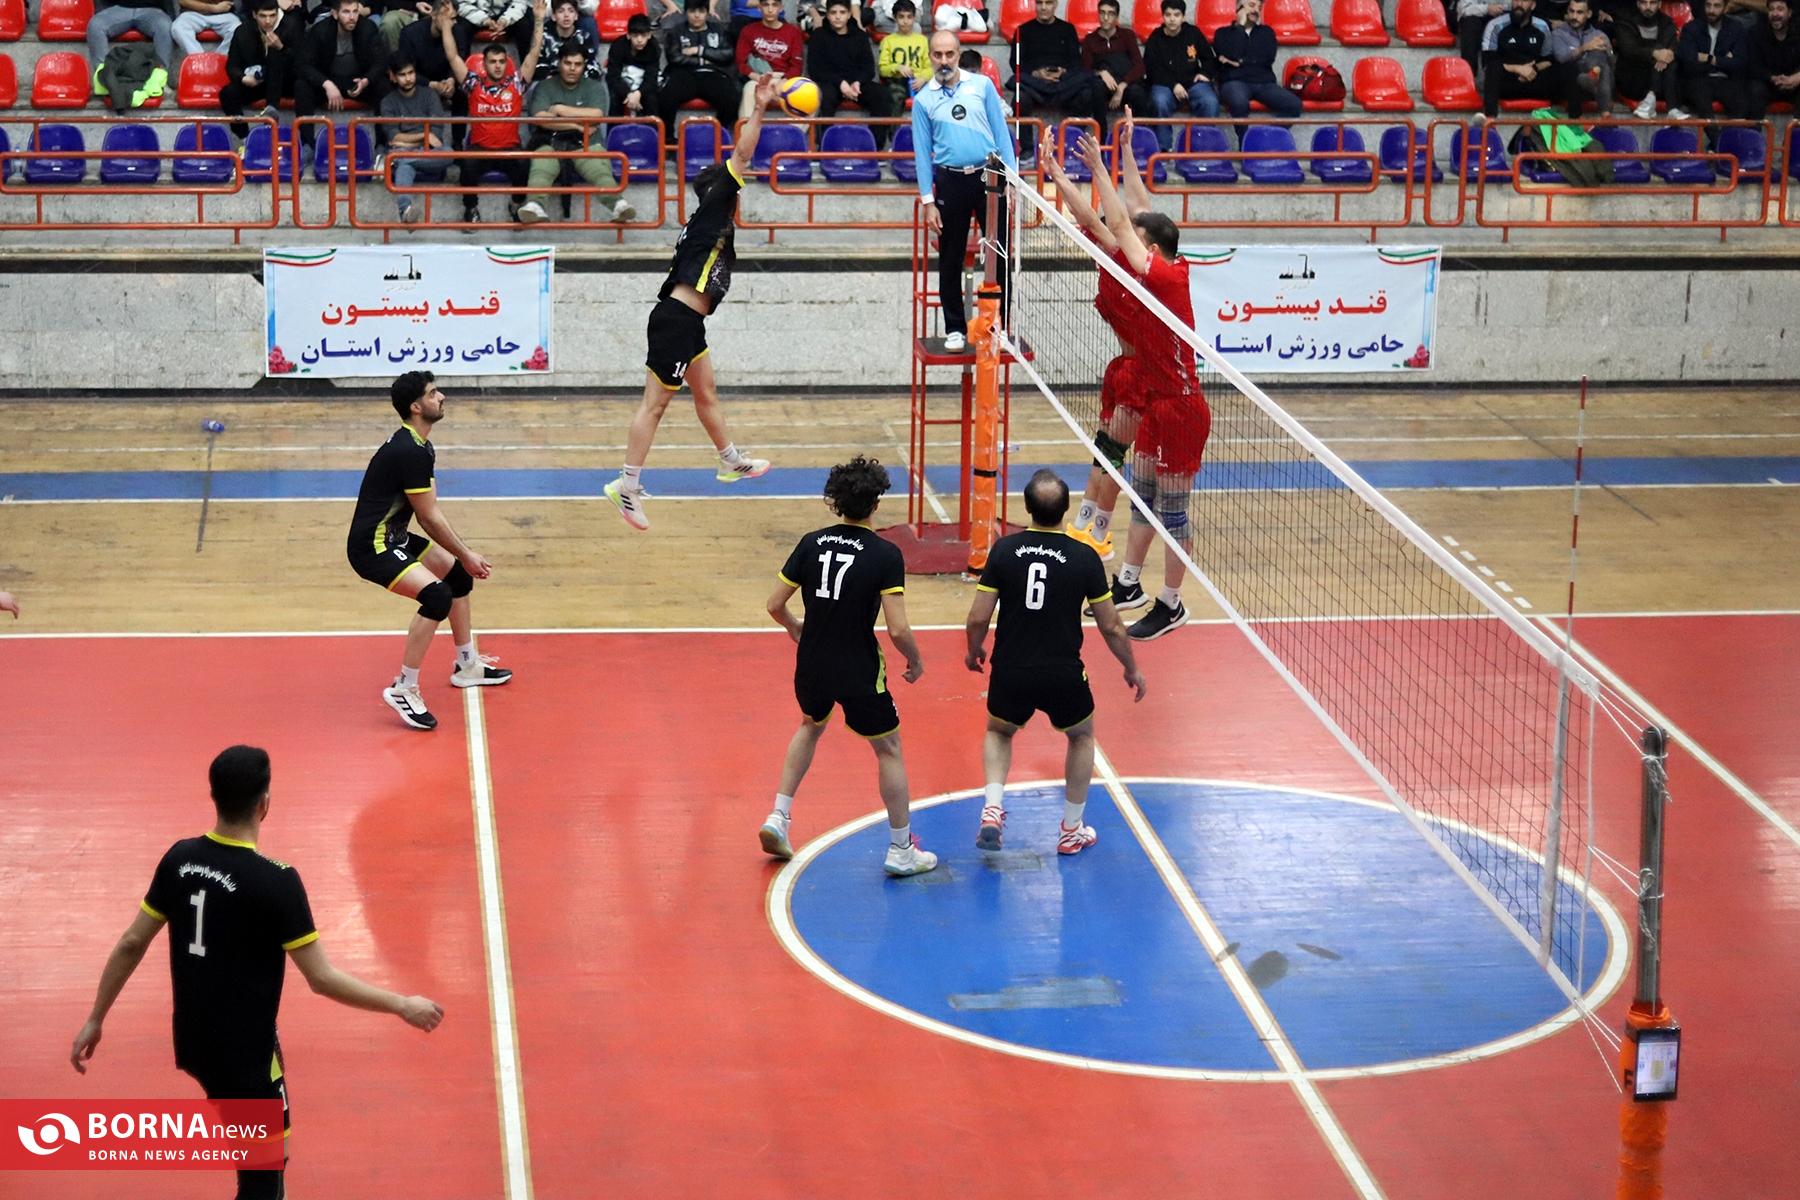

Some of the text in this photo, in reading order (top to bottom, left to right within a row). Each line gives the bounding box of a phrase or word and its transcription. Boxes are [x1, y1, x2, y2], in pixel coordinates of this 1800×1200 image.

[892, 46, 921, 68] OK
[321, 290, 501, 326] قند بیستون
[1217, 290, 1388, 323] قند بیستون
[301, 336, 521, 364] حامی ورزش استان
[1196, 334, 1405, 360] حامی ورزش استا
[816, 550, 856, 600] 17
[1025, 562, 1048, 610] 6
[188, 889, 206, 957] 1
